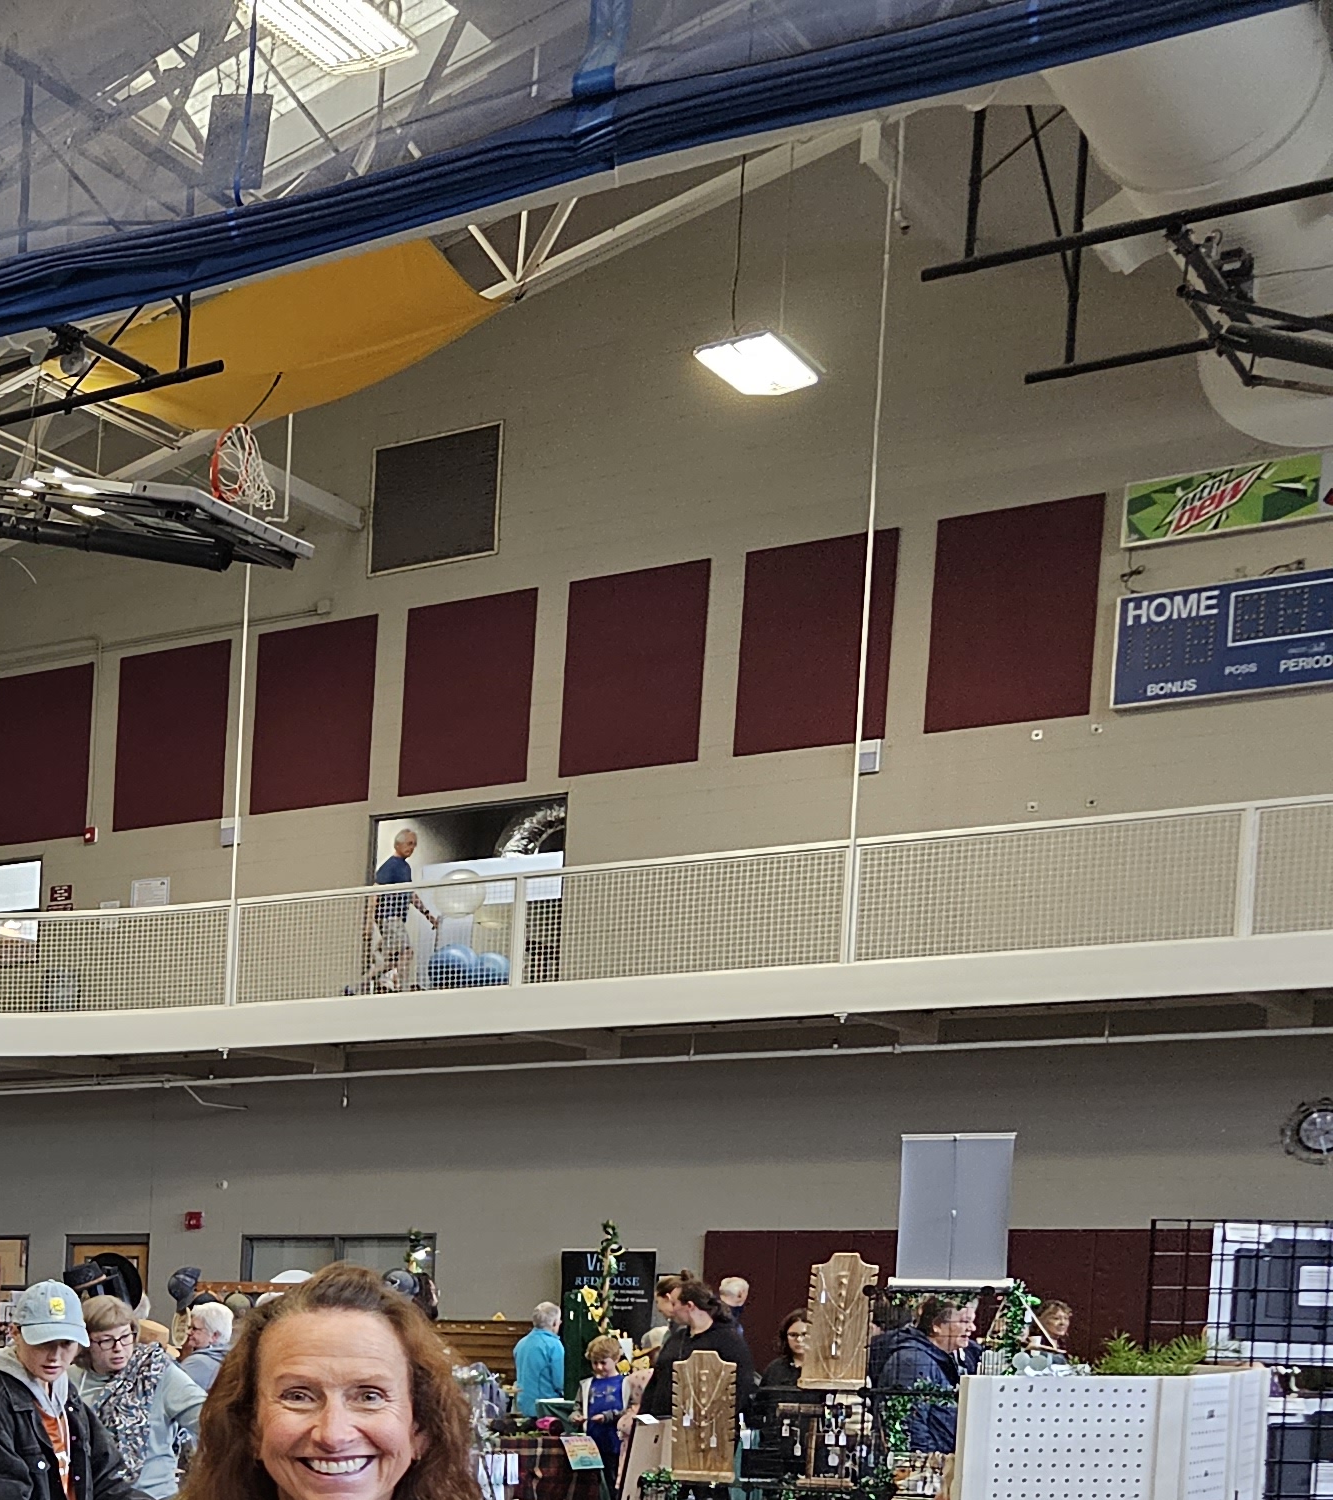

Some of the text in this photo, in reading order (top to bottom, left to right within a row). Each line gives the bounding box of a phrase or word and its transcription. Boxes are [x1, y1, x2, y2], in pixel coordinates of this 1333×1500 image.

[1126, 589, 1221, 626] HOME
[1224, 662, 1258, 676] POSS
[1279, 654, 1333, 673] PERIOD
[1146, 678, 1198, 697] BONUS
